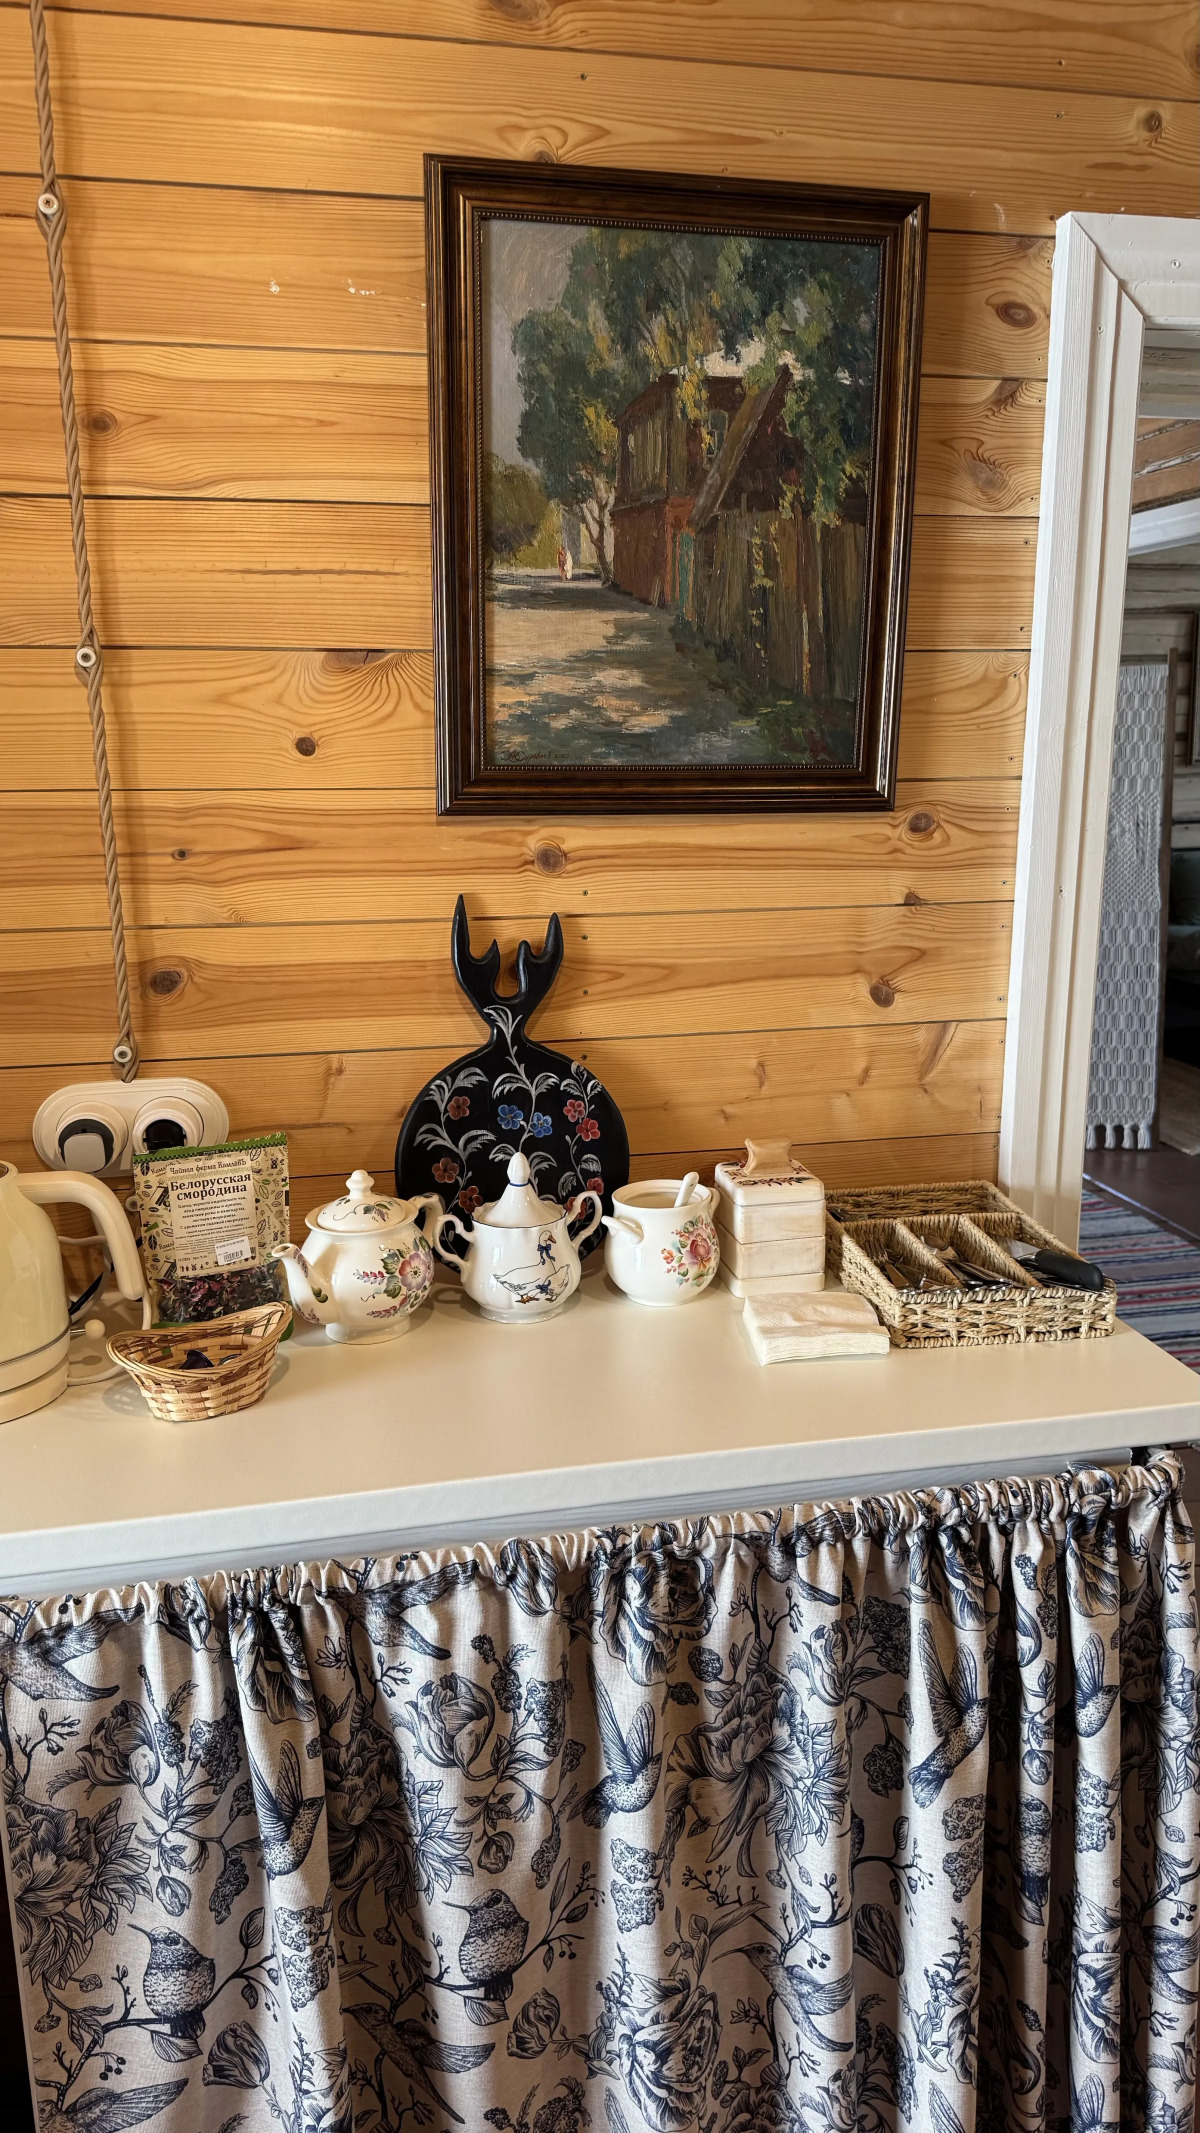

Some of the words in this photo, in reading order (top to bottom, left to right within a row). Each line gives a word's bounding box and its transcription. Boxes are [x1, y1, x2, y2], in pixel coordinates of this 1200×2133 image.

[170, 1167, 194, 1175] Чайная
[196, 1164, 217, 1172] ферма
[170, 1173, 251, 1191] Белорусская
[176, 1184, 247, 1201] смородина
